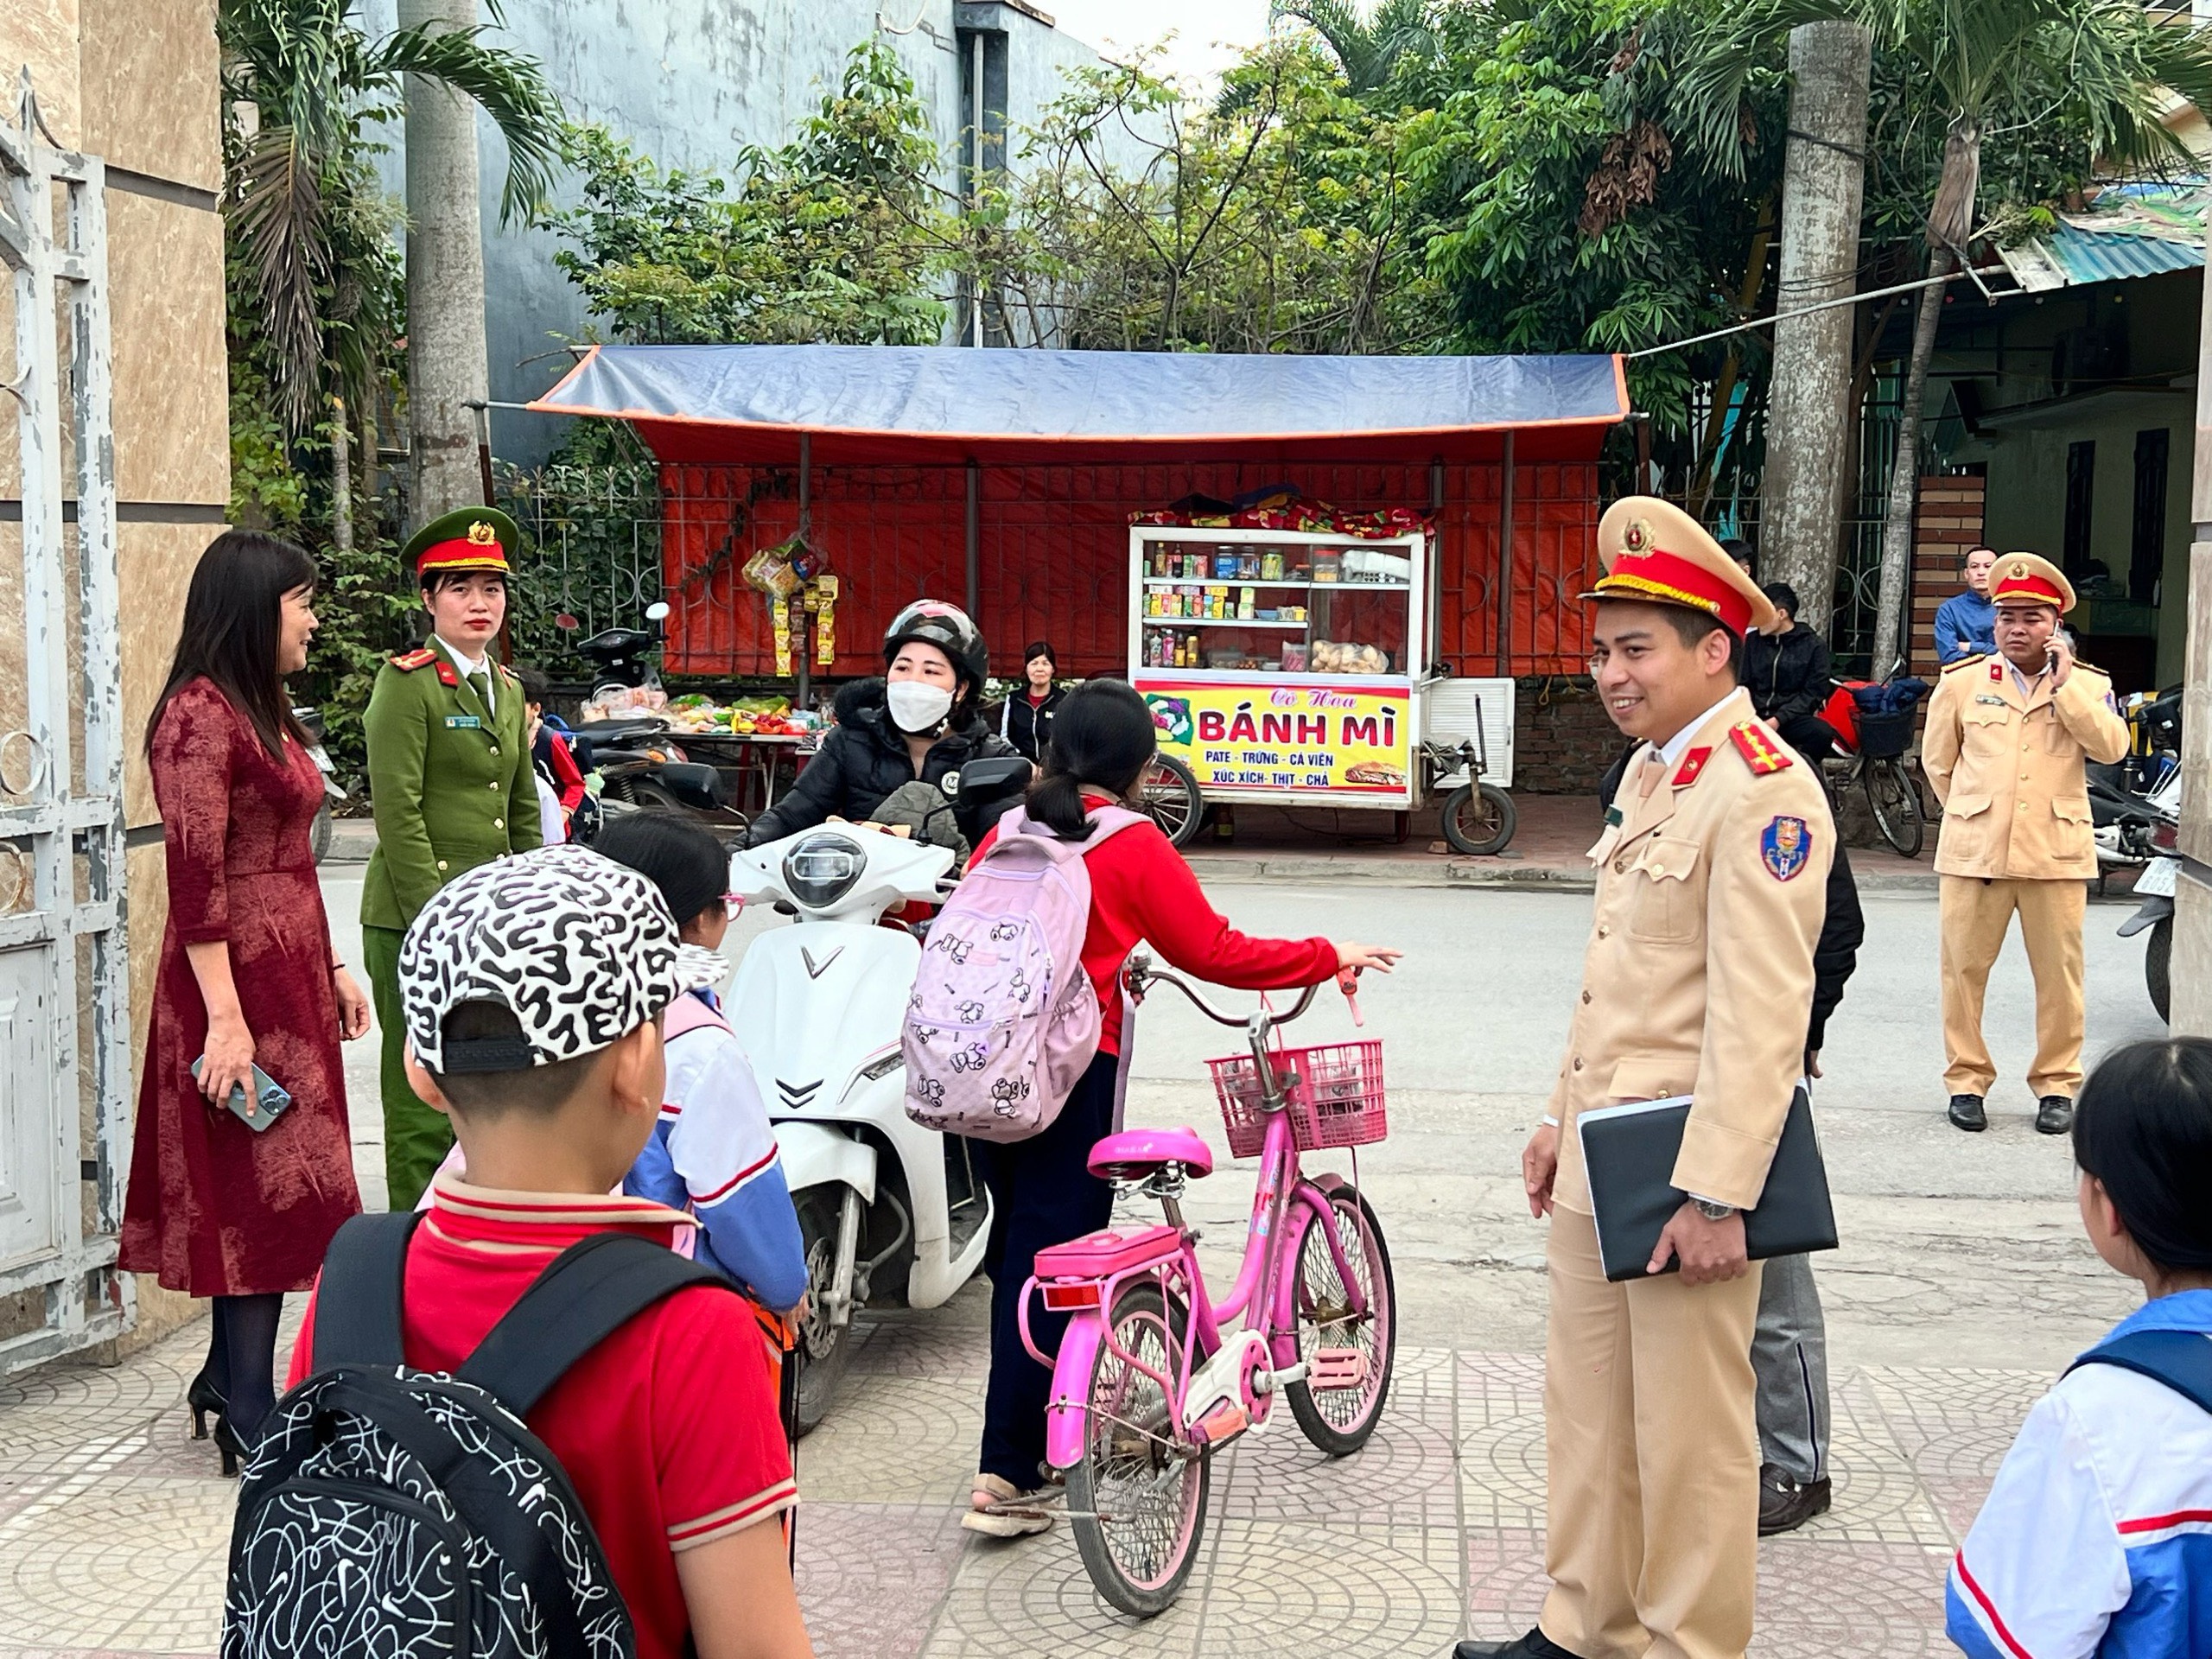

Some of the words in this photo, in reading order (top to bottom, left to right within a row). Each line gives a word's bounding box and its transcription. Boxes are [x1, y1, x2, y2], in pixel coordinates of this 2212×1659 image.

[1270, 689, 1297, 706] Cô
[1309, 690, 1357, 708] Hoa
[1198, 702, 1325, 744] BÁNH
[1342, 706, 1395, 747] MÌ
[1205, 751, 1231, 763] PATE
[1242, 750, 1279, 765] TRỨNG
[1307, 752, 1333, 766] VIÊN
[1212, 768, 1235, 783] XÚC
[1272, 772, 1296, 787] THỊT
